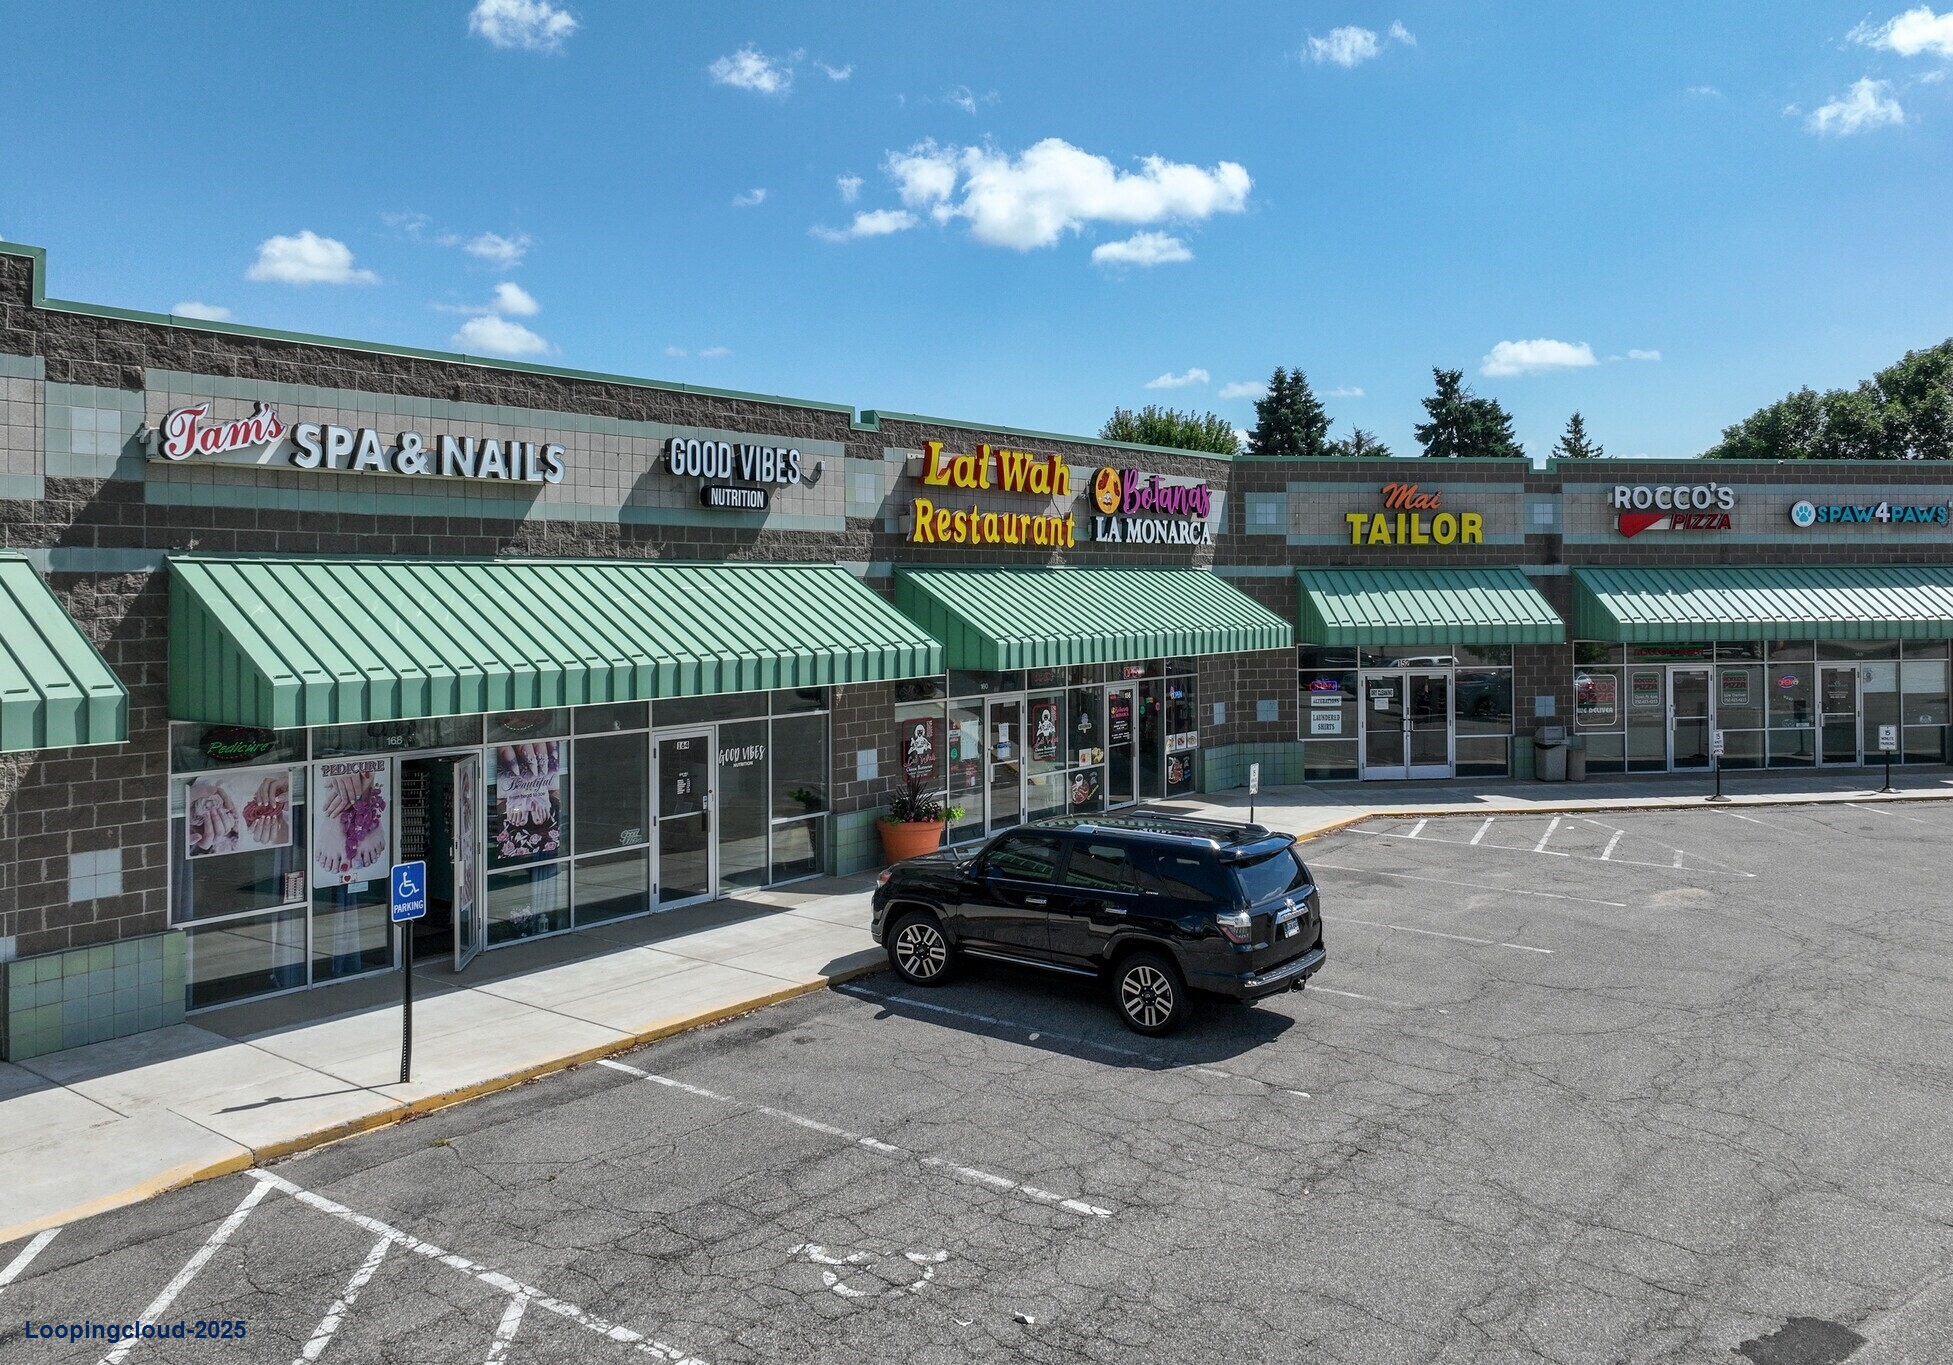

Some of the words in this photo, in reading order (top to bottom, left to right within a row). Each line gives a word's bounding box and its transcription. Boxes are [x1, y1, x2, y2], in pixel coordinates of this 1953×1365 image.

[162, 400, 288, 461] Tam's
[293, 422, 387, 472] SPA
[394, 429, 431, 476] &
[440, 433, 567, 485] NAILS
[665, 436, 732, 478] GOOD
[735, 443, 801, 484] VIBES
[921, 440, 991, 491] Lat
[995, 449, 1071, 496] Wah
[710, 486, 765, 508] NUTRITION
[1122, 467, 1212, 519] Botanas
[1381, 482, 1442, 510] Mai
[1614, 482, 1735, 510] ROCCO'S
[911, 497, 1076, 549] Restaurant
[1095, 515, 1123, 543] LA
[1125, 518, 1213, 546] MONARCA
[1345, 512, 1484, 545] TAILOR
[1669, 512, 1732, 531] PIZZA
[1723, 681, 1747, 689] PIZZA
[1588, 706, 1614, 714] DELIVER
[208, 739, 269, 754] Pedicure
[386, 735, 403, 746] 168
[718, 747, 740, 766] GOOD
[742, 745, 766, 760] VIBES
[321, 760, 385, 778] PEDICURE
[501, 774, 555, 793] Beautiful
[393, 900, 424, 914] PARKING
